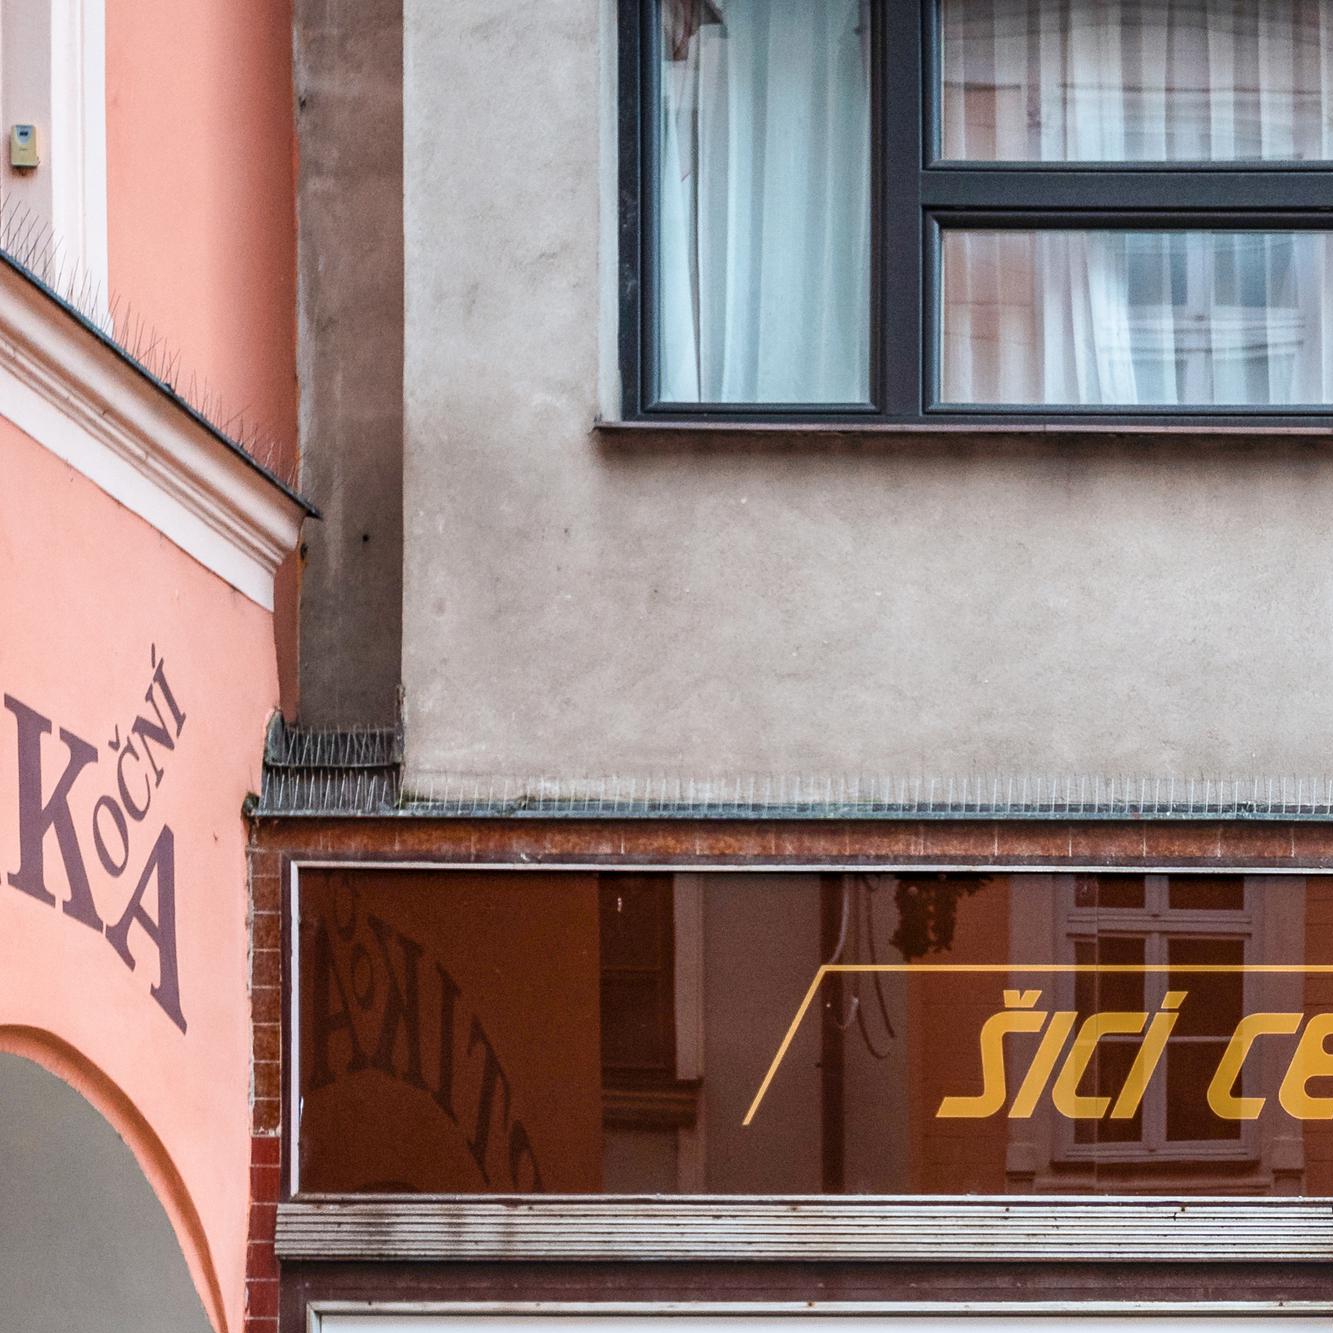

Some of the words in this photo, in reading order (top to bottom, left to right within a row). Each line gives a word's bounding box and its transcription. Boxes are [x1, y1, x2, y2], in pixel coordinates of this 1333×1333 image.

[0, 692, 188, 1036] KA
[92, 642, 187, 878] OČNÍ
[935, 989, 1188, 1119] ŠICÍ
